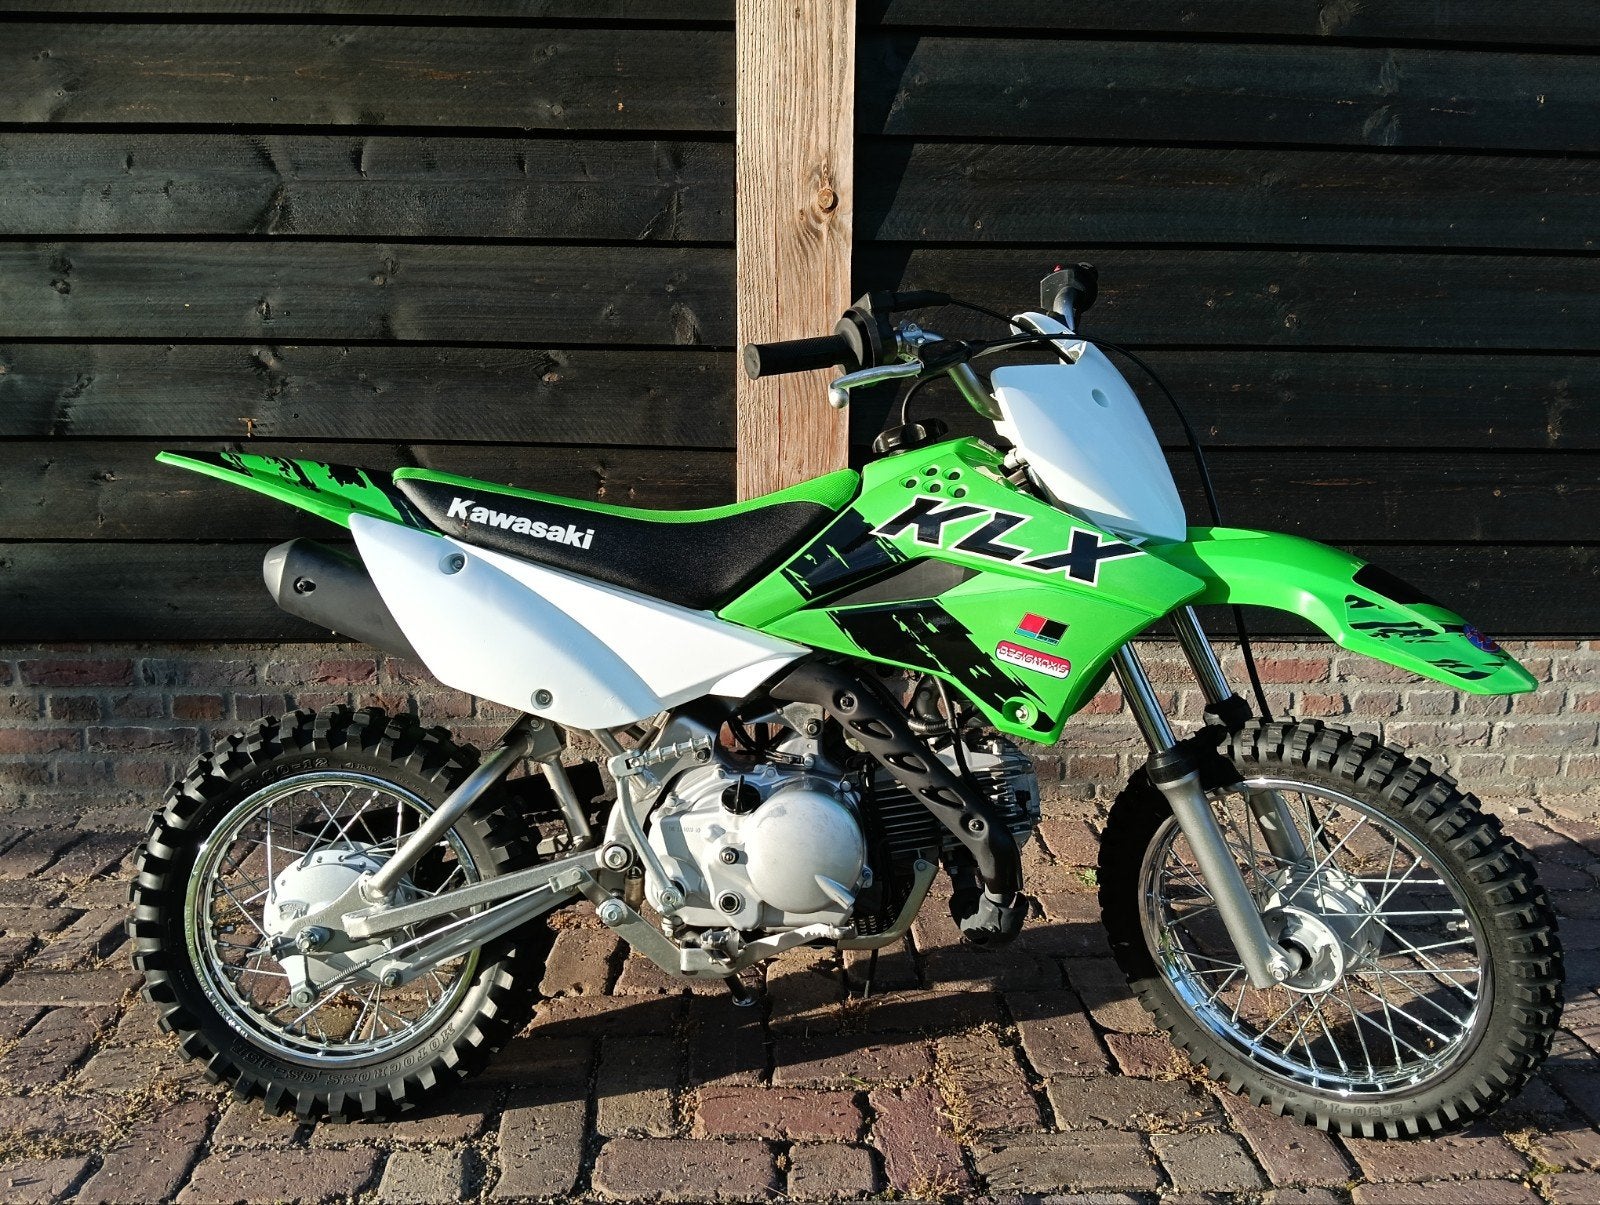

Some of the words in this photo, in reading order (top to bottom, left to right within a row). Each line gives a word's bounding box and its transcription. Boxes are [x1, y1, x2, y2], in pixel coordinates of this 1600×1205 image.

[446, 497, 595, 550] Kawasaki
[868, 496, 1146, 587] KLX
[999, 645, 1068, 674] DESIGNAXIS
[325, 1022, 456, 1086] MOTOCROSS
